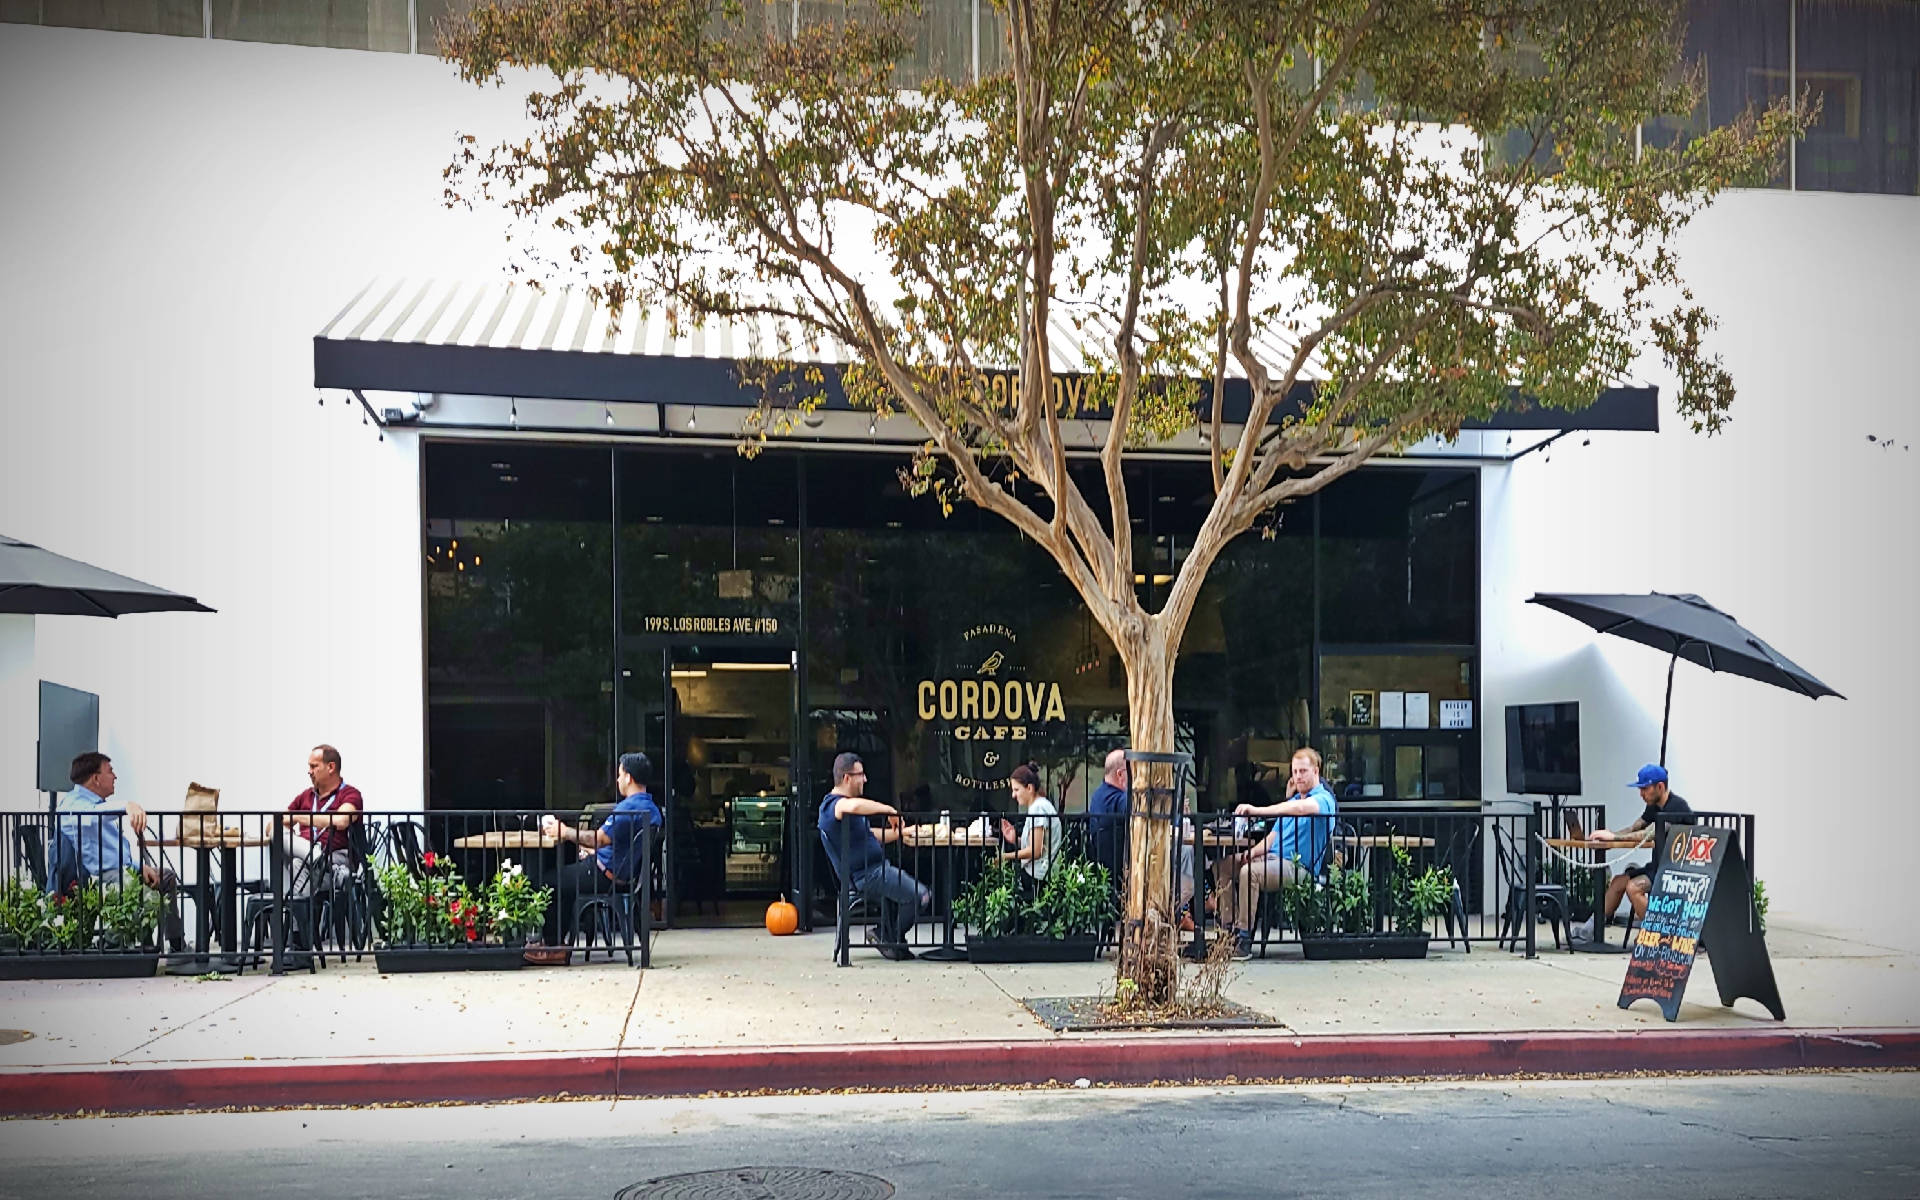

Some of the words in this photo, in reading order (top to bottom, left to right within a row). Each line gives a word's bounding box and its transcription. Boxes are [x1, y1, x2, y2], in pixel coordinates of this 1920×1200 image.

[974, 373, 1100, 413] COROVA
[645, 617, 661, 631] 199
[663, 617, 672, 631] S.
[674, 617, 692, 632] LOS
[694, 617, 731, 632] ROBLES
[755, 618, 778, 633] #150
[963, 624, 1017, 643] PASADENA
[918, 680, 1066, 722] CORDOVA
[954, 726, 1027, 740] CAFE
[984, 751, 1000, 767] &
[955, 773, 1012, 790] BOTTLES
[1637, 928, 1660, 947] BEER
[1672, 935, 1696, 955] WINE
